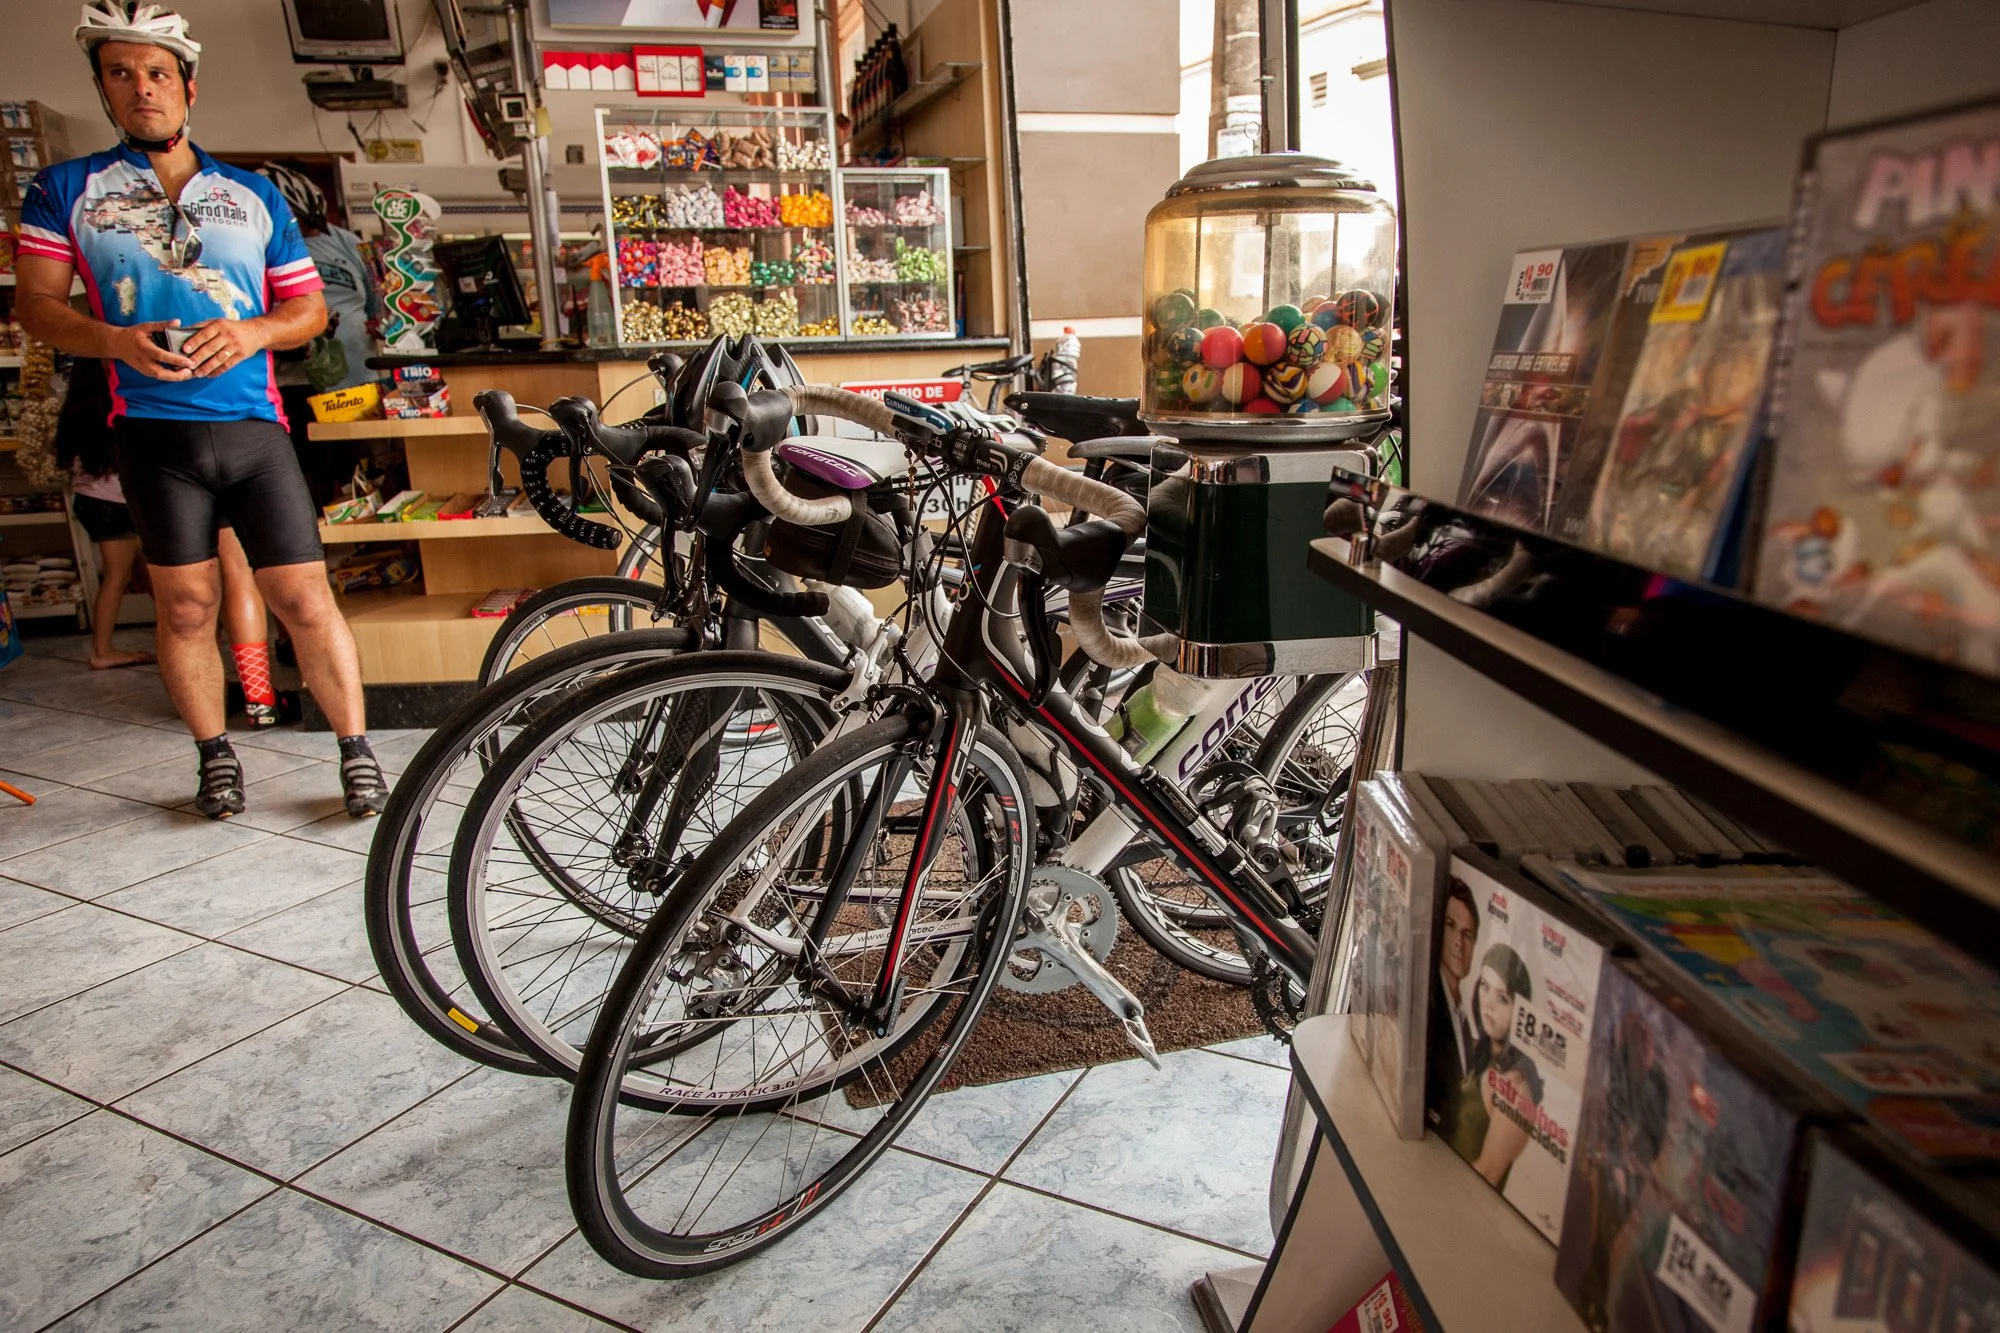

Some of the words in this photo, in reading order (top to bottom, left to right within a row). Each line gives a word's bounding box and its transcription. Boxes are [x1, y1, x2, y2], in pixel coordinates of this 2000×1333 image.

[402, 366, 433, 378] TRIO
[925, 386, 944, 399] DE
[322, 397, 364, 413] Talento
[400, 408, 421, 418] TRIO
[885, 398, 911, 414] GARMIN
[787, 446, 858, 478] corratec
[660, 1087, 703, 1099] RACE
[705, 1086, 768, 1099] ATTACK
[770, 1081, 796, 1092] 3.0
